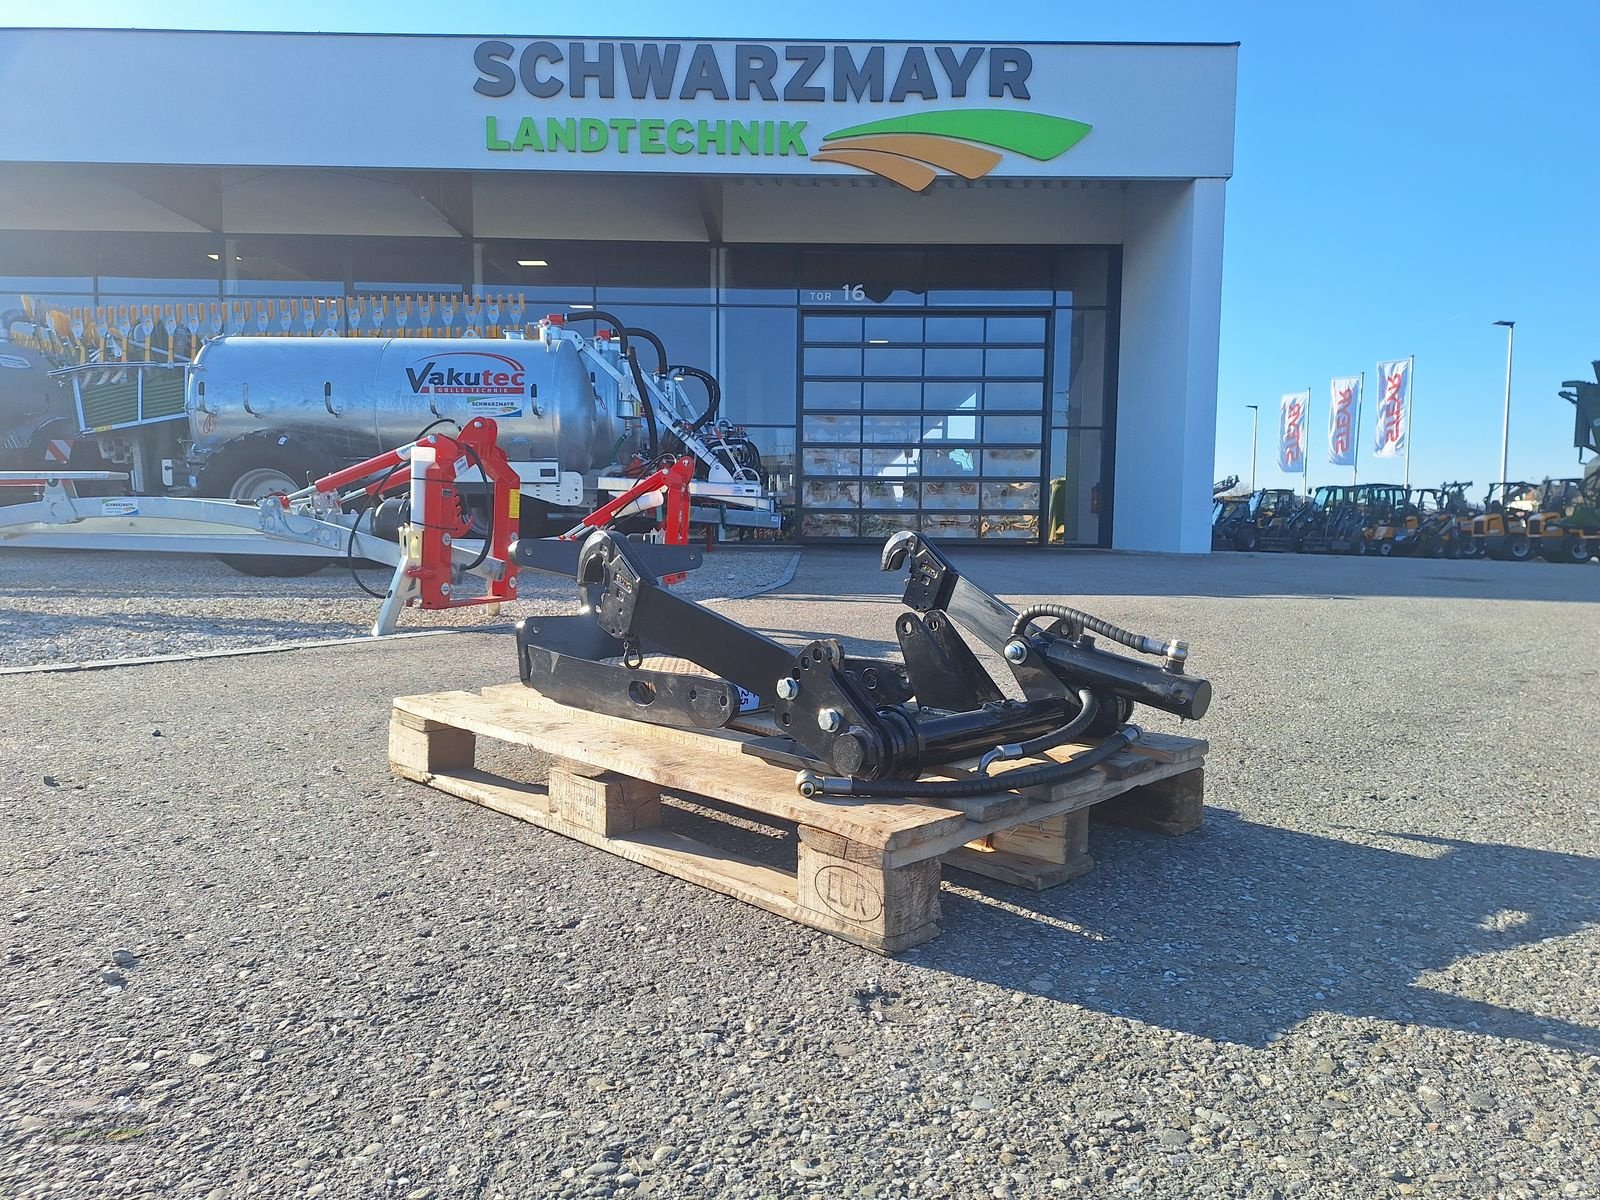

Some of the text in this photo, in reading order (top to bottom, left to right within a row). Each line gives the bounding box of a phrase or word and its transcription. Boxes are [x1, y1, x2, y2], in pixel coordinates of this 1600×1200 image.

[473, 40, 1033, 102] SCHWARZMAYR
[486, 116, 808, 156] LANDTECHNIK
[810, 284, 866, 301] TOR 16
[405, 362, 525, 394] Vakutec
[826, 871, 867, 917] EUR
